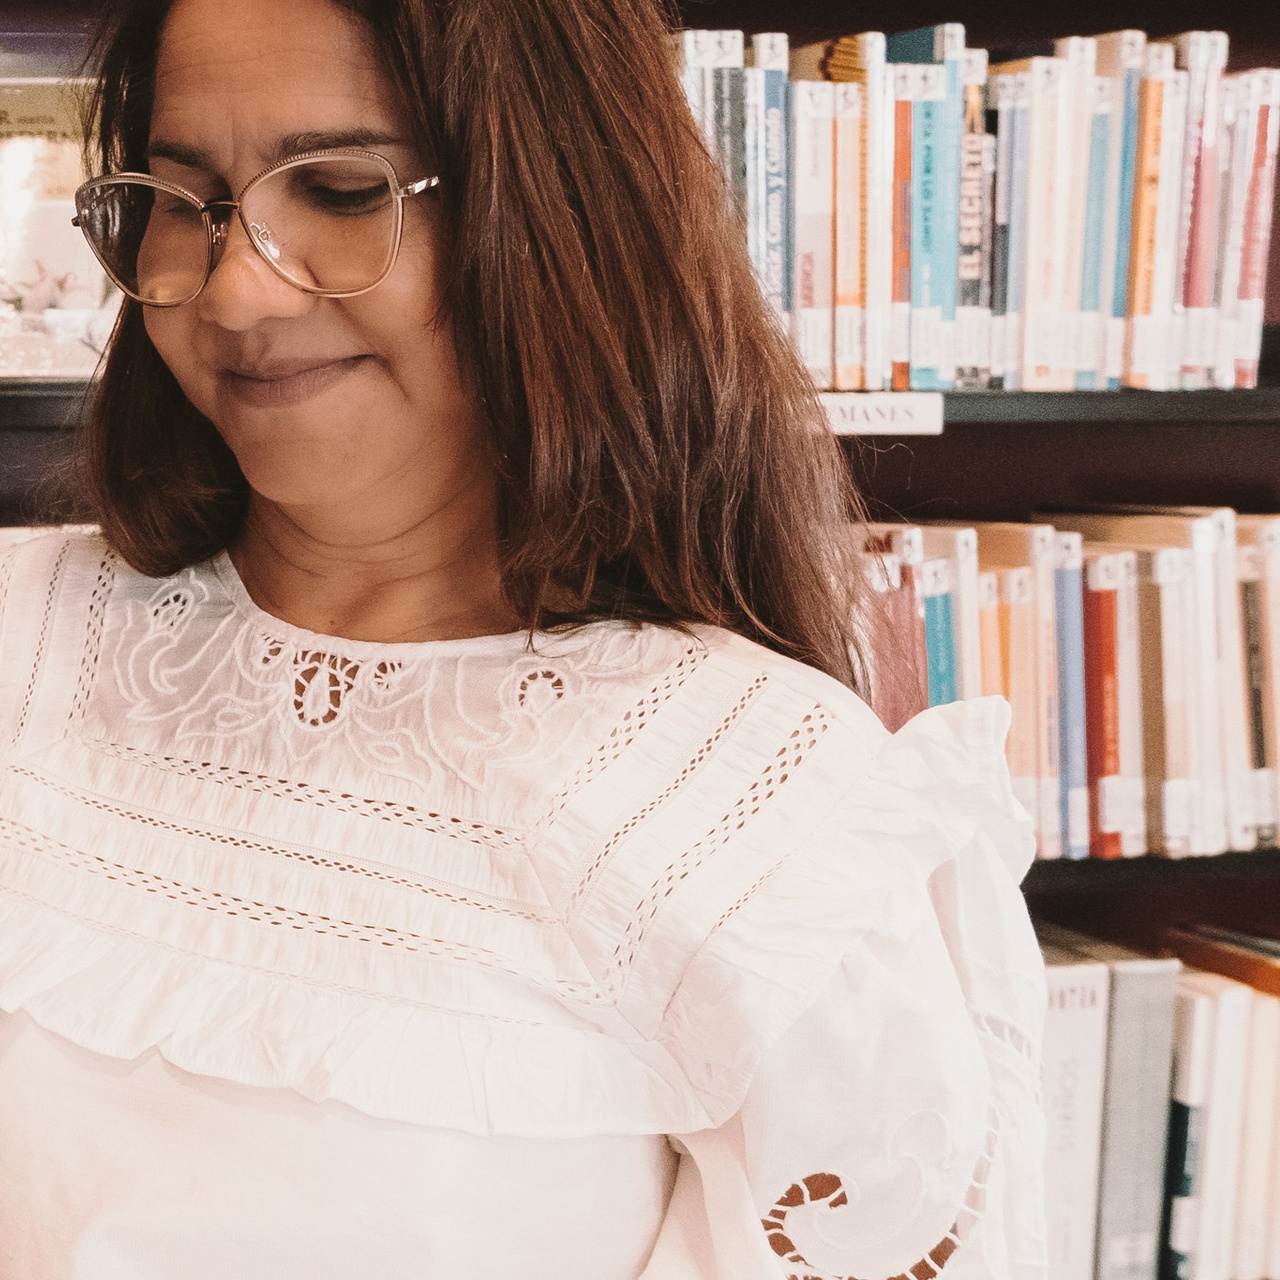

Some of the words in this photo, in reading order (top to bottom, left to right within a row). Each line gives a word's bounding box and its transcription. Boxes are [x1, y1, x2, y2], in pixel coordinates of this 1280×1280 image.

[959, 134, 982, 246] SECRETO
[959, 252, 980, 280] EL
[838, 405, 916, 424] MANES
